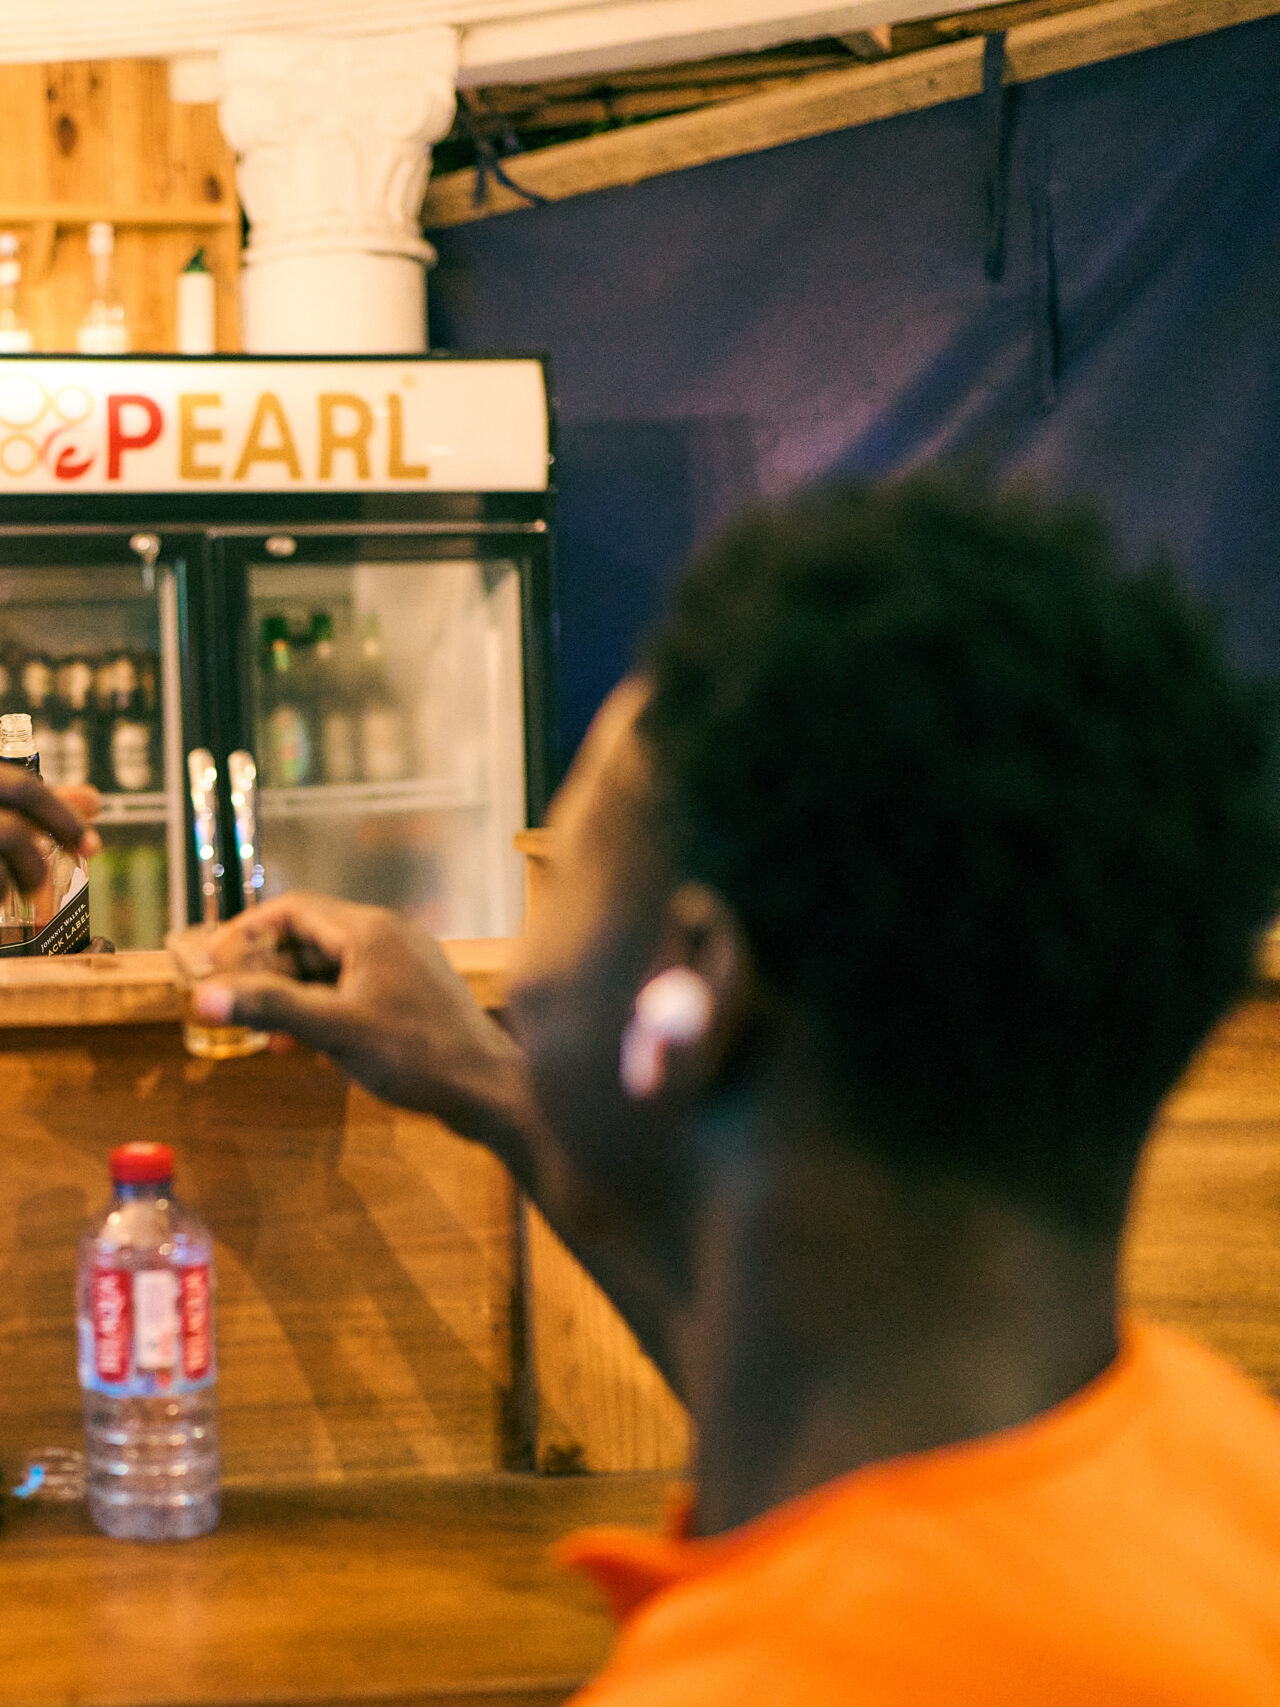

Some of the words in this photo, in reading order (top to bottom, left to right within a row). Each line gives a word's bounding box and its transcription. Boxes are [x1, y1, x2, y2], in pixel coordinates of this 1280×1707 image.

[107, 391, 430, 481] PEARL
[40, 925, 64, 953] JOHNNIE
[63, 903, 86, 926] WALKER
[48, 938, 64, 956] ACK
[65, 912, 90, 939] LABEL
